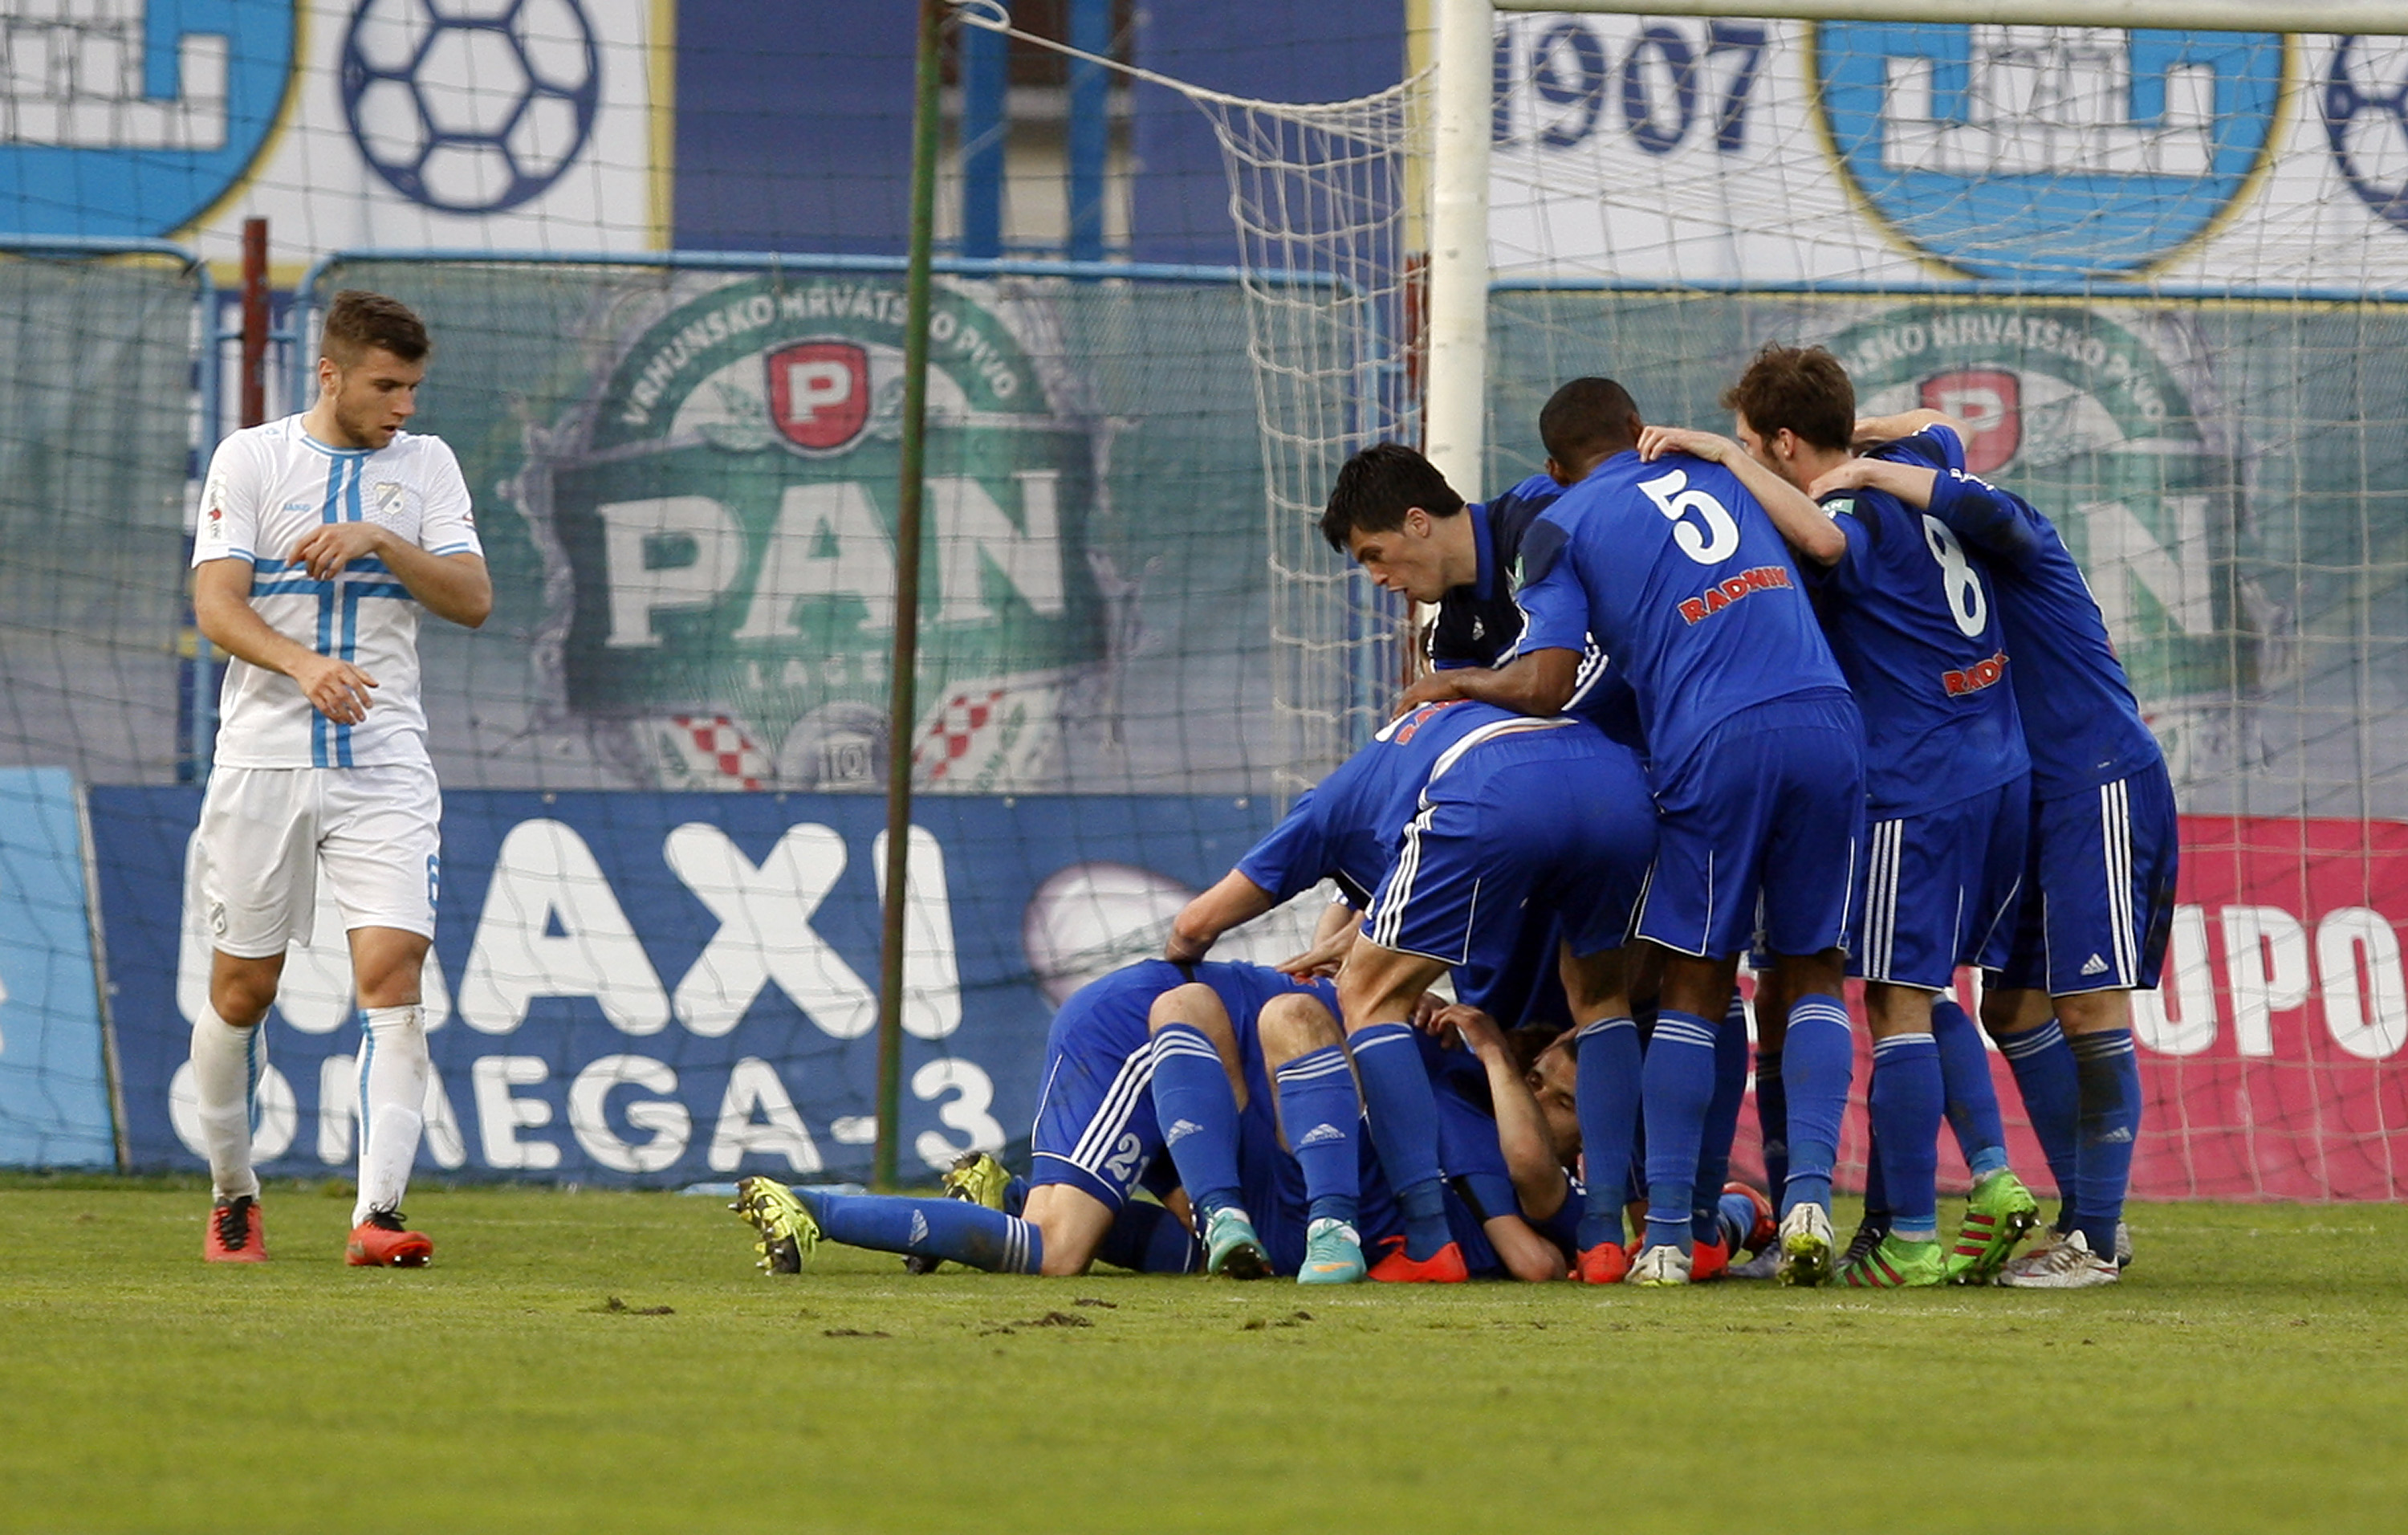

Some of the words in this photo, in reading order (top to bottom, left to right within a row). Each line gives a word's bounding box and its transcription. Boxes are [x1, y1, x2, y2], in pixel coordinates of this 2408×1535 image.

[1491, 22, 1766, 153] 1907
[621, 294, 775, 425] VRHUNSKO
[782, 286, 957, 341] HRVATSO
[953, 328, 1019, 398] PIVO
[787, 361, 852, 424] P
[596, 469, 1064, 648] PAN
[1637, 469, 1739, 564] 5
[1922, 513, 1987, 637] 8
[1678, 566, 1794, 626] RADNIK
